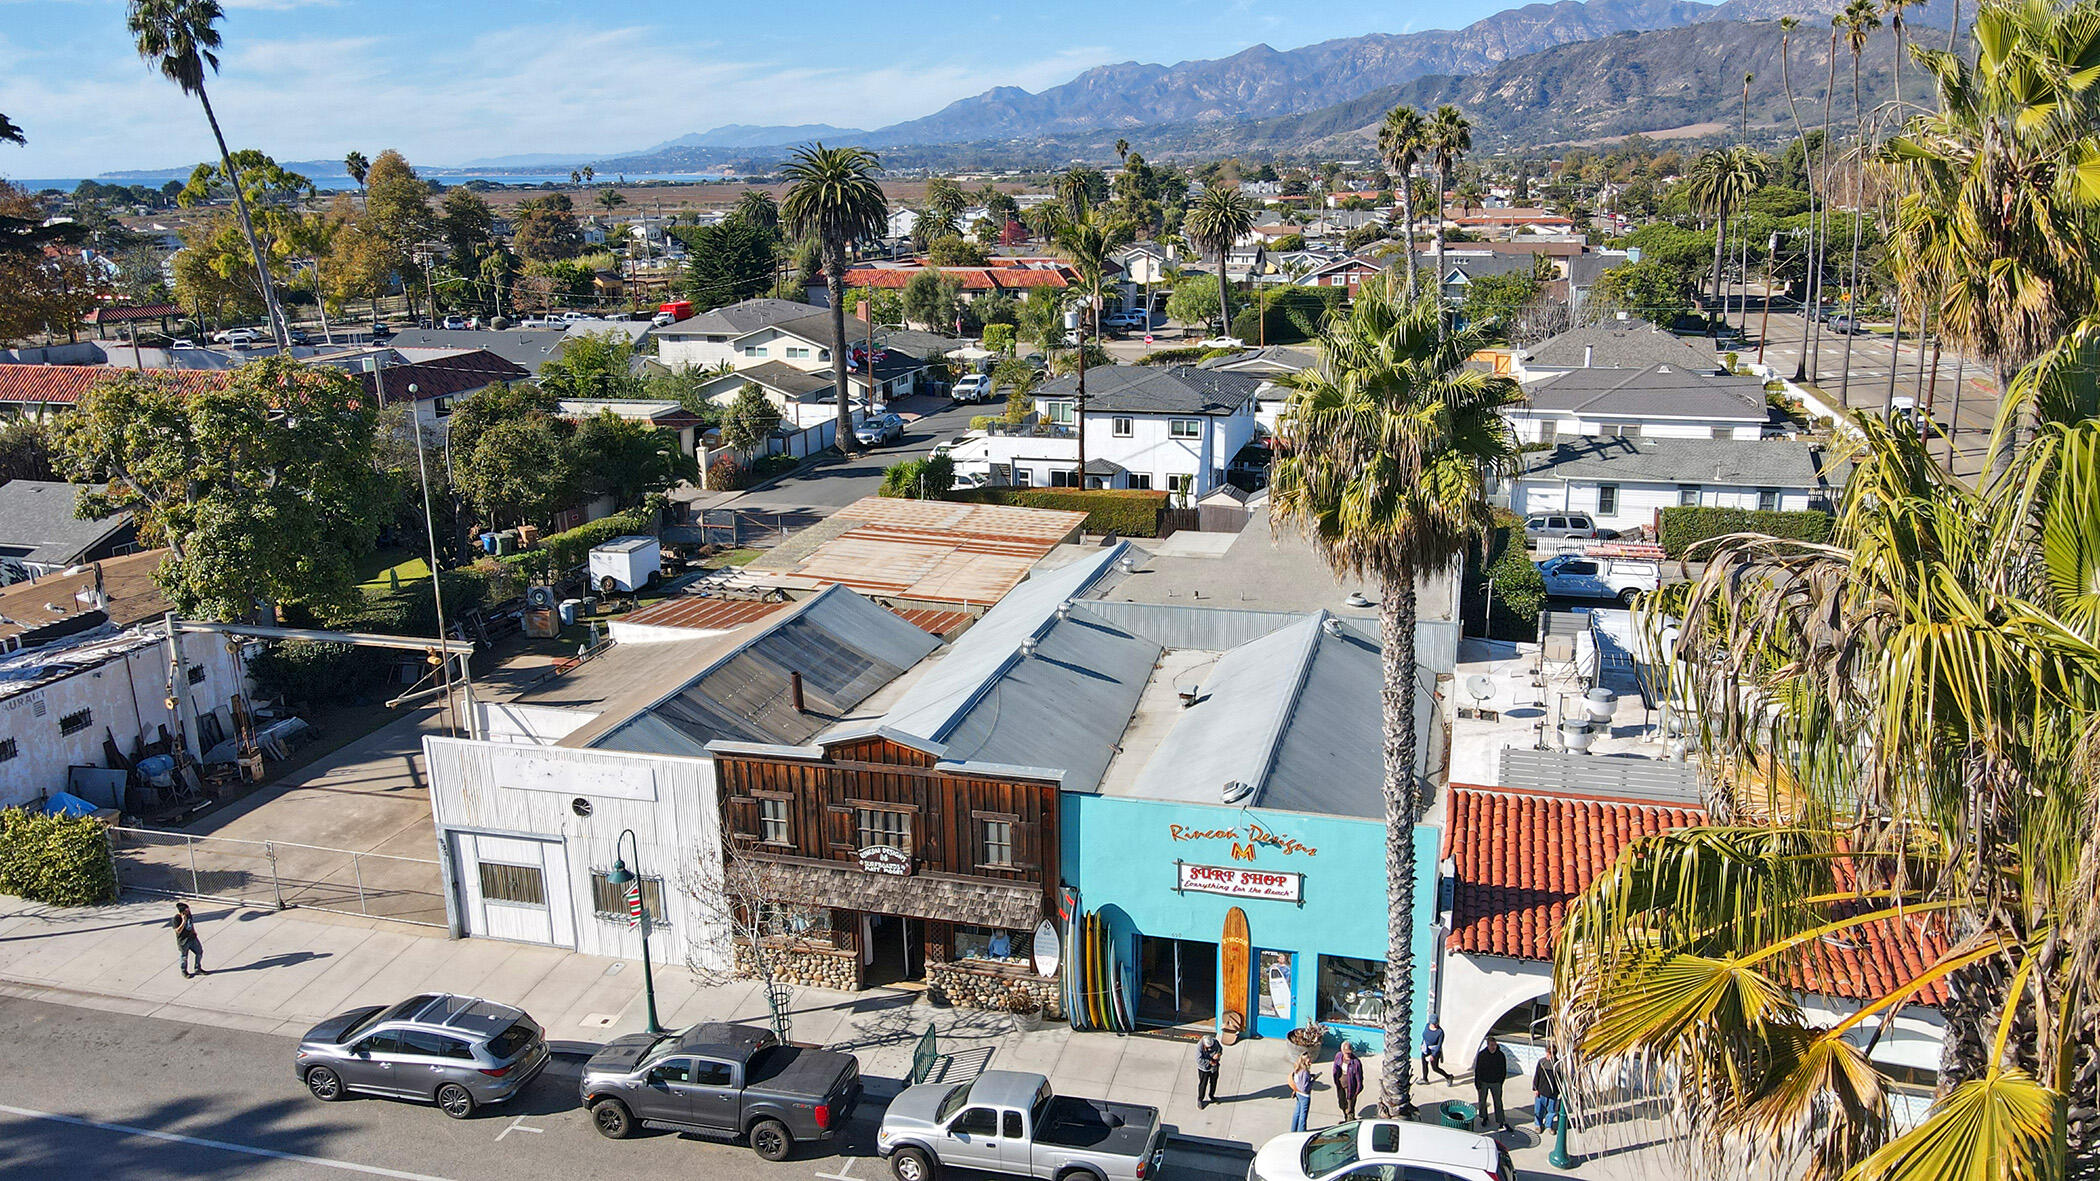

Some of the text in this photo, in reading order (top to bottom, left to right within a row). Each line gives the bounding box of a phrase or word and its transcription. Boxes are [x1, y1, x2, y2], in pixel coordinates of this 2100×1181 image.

[1170, 823, 1317, 856] Rincon Designs
[1190, 867, 1287, 887] SURF SHOP
[1232, 885, 1246, 893] for
[1248, 887, 1262, 895] the
